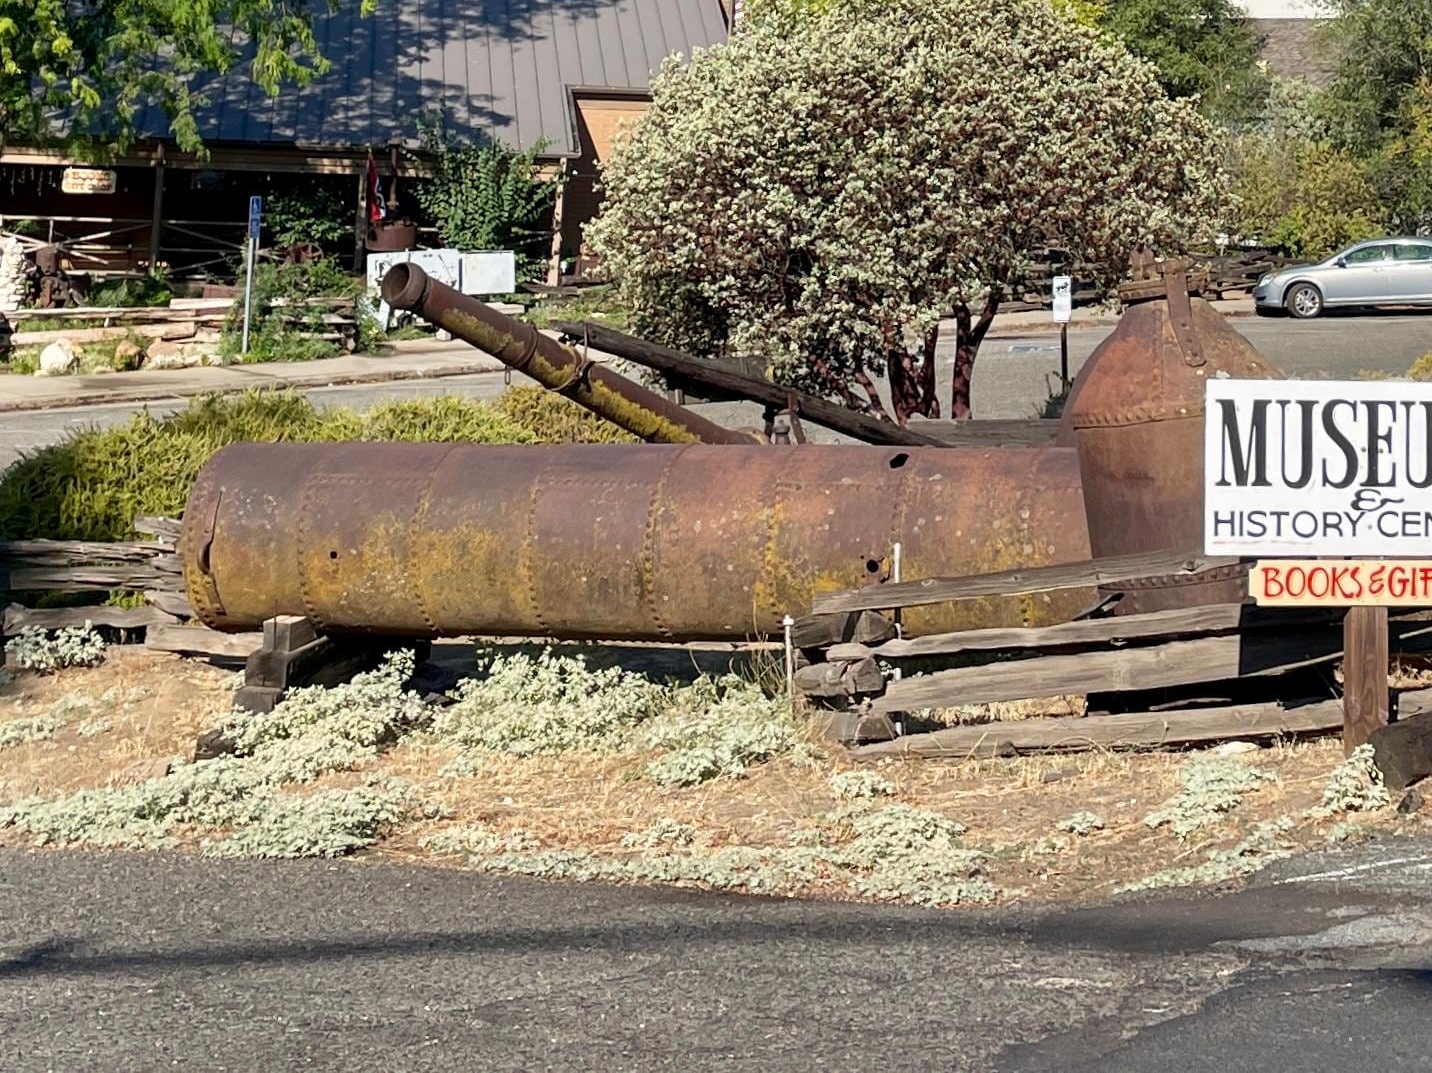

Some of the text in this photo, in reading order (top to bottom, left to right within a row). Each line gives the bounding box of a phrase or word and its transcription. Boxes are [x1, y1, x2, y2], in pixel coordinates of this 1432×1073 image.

[1351, 489, 1404, 512] &
[1214, 510, 1365, 538] HISTORY
[1261, 566, 1363, 599] BOOKS
